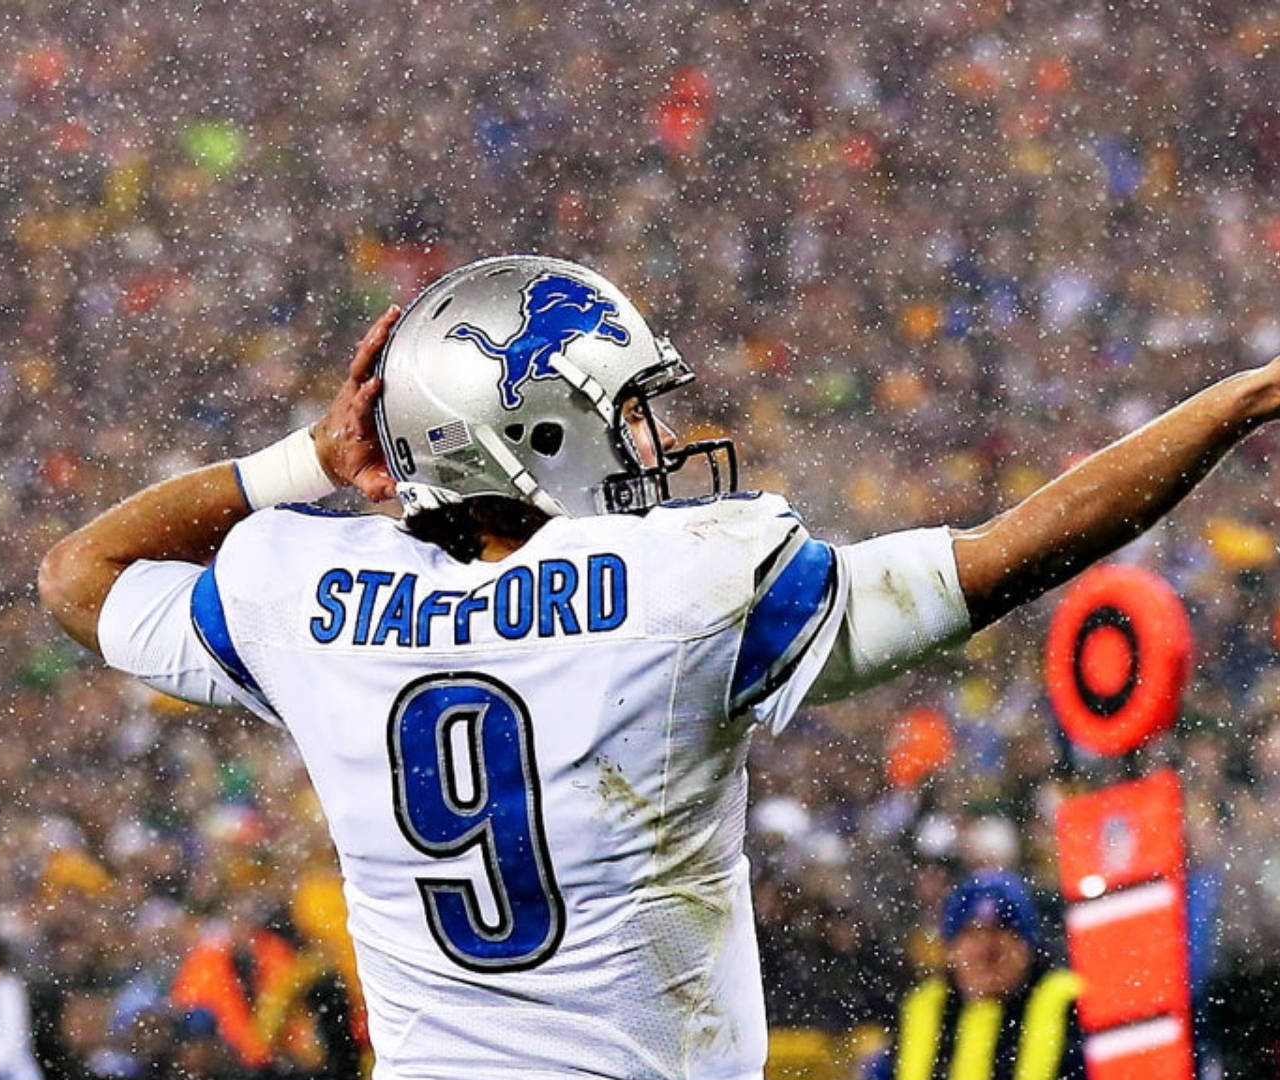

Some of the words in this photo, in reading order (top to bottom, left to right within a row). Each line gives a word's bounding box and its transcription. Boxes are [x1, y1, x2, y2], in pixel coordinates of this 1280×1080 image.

[395, 436, 416, 475] 9
[310, 553, 627, 647] STAFFORD
[387, 671, 567, 974] 9
